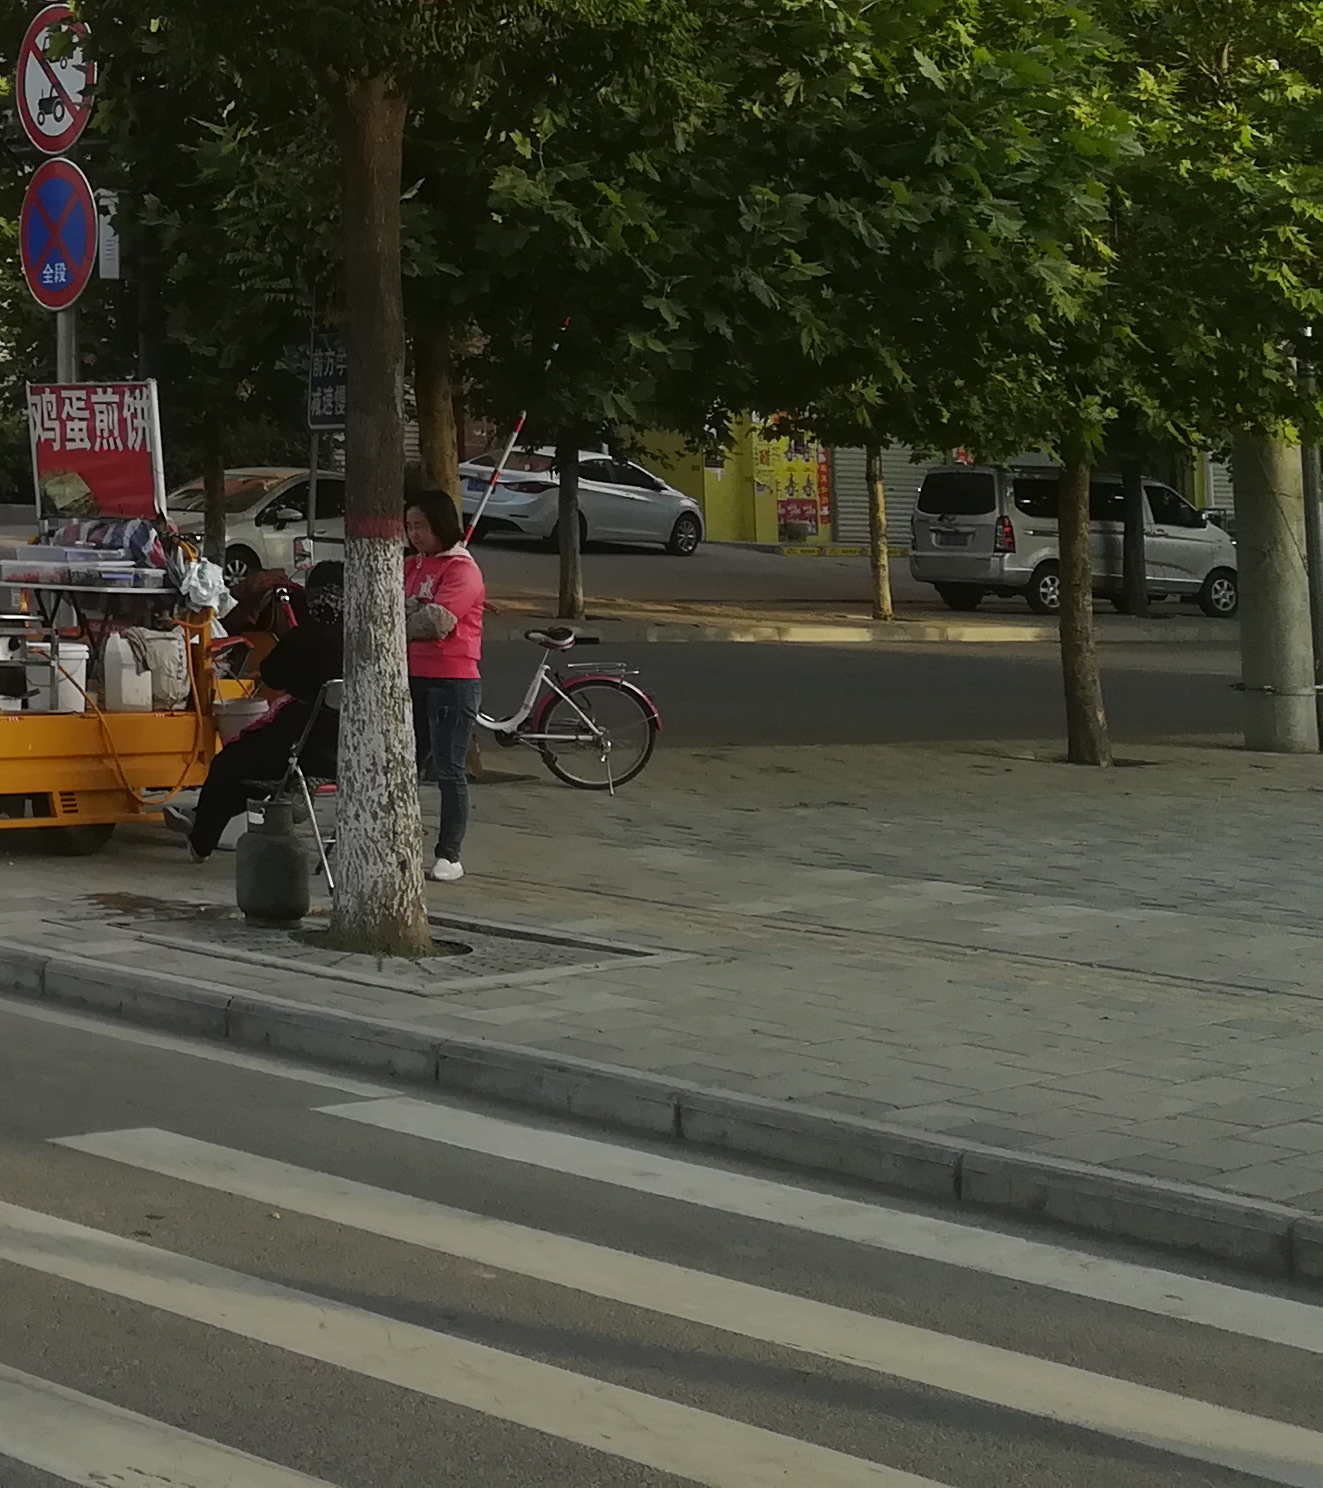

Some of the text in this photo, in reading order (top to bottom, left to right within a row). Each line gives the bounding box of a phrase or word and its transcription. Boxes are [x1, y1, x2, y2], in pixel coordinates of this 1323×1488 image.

[42, 262, 67, 284] 全段
[23, 387, 152, 452] 鸡蛋煎饼
